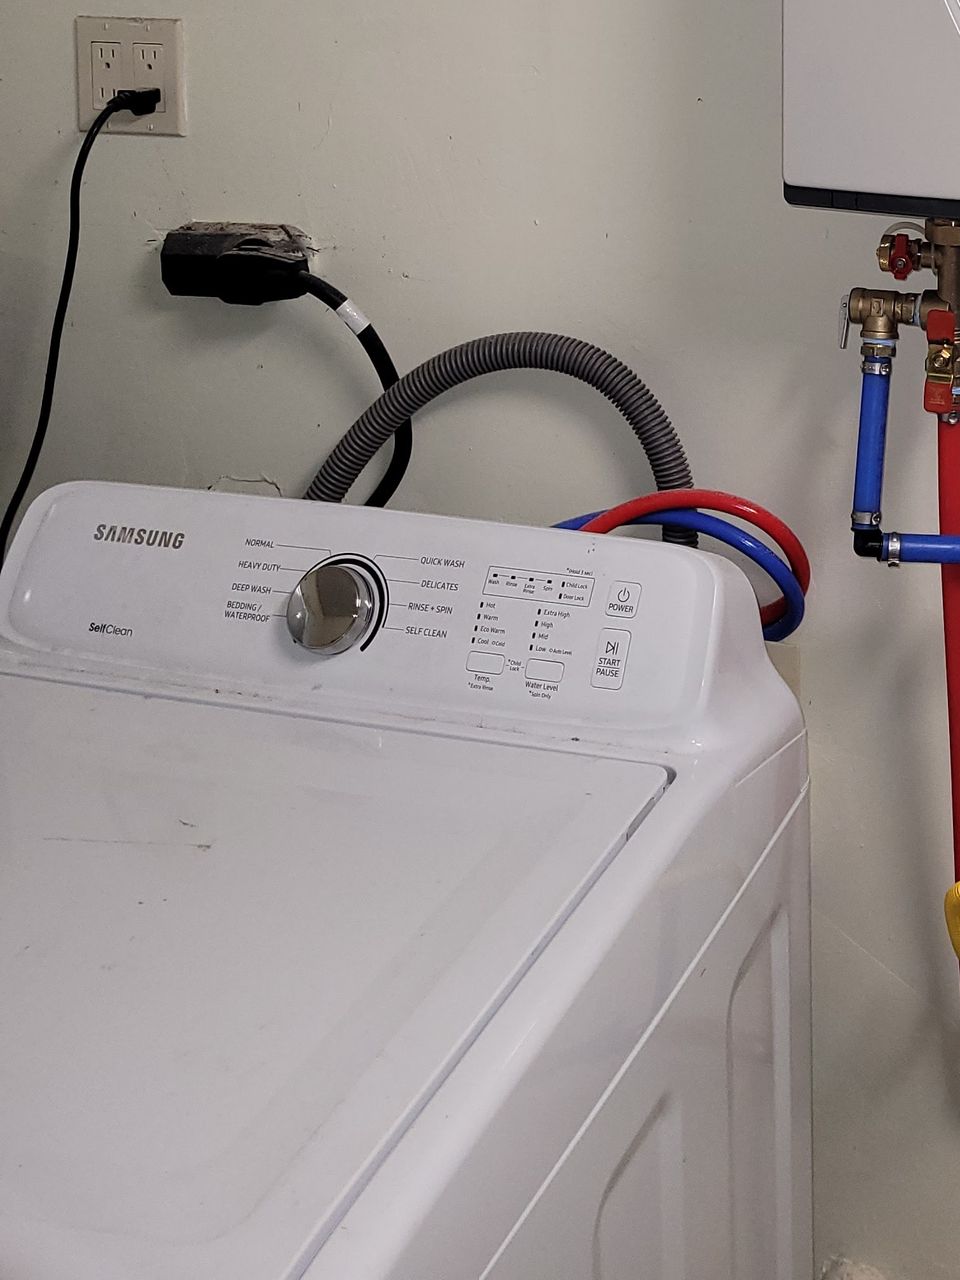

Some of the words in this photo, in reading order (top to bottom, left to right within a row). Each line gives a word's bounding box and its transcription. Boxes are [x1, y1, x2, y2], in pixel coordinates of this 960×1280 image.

[94, 524, 185, 549] SAMSUNG
[245, 538, 274, 548] NORMAL
[239, 561, 261, 570] HEAVY
[262, 562, 280, 572] DUTY
[420, 556, 443, 566] QUICK
[444, 559, 465, 568] WASH
[232, 583, 250, 592] DEEP
[251, 585, 271, 594] WASH
[421, 580, 458, 591] DELICATES
[227, 601, 257, 610] BEDDING
[408, 602, 429, 612] RINSE
[436, 605, 452, 615] SPIN
[608, 604, 633, 614] POWER
[224, 610, 270, 622] WATERPROOF
[88, 622, 133, 636] SelfClean
[405, 626, 423, 635] SELF
[424, 628, 447, 638] CLEAN
[599, 658, 620, 667] START
[596, 668, 619, 677] PAUSE
[525, 681, 542, 689] Water
[543, 683, 558, 691] Level
